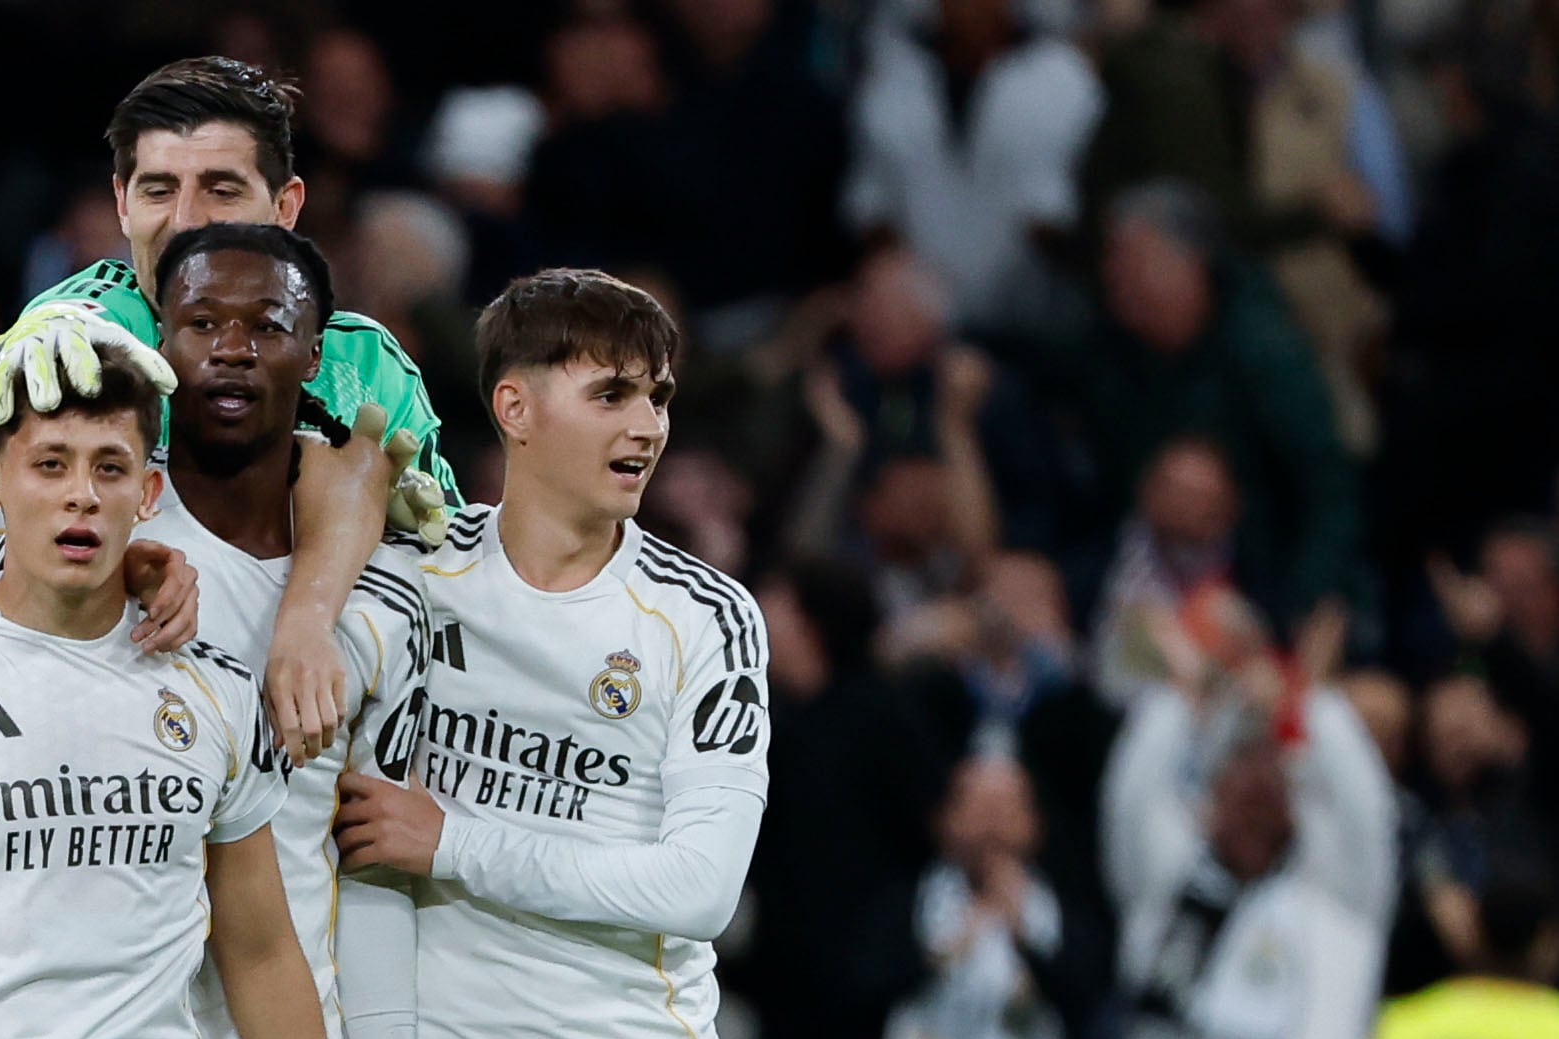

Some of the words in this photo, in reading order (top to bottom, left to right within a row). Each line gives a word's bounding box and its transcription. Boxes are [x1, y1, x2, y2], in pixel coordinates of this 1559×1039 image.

[418, 703, 632, 787] mirates
[694, 675, 766, 753] hp
[425, 751, 471, 799] FLY
[474, 767, 591, 821] BETTER
[5, 827, 56, 872] FLY
[67, 824, 176, 867] BETTER
